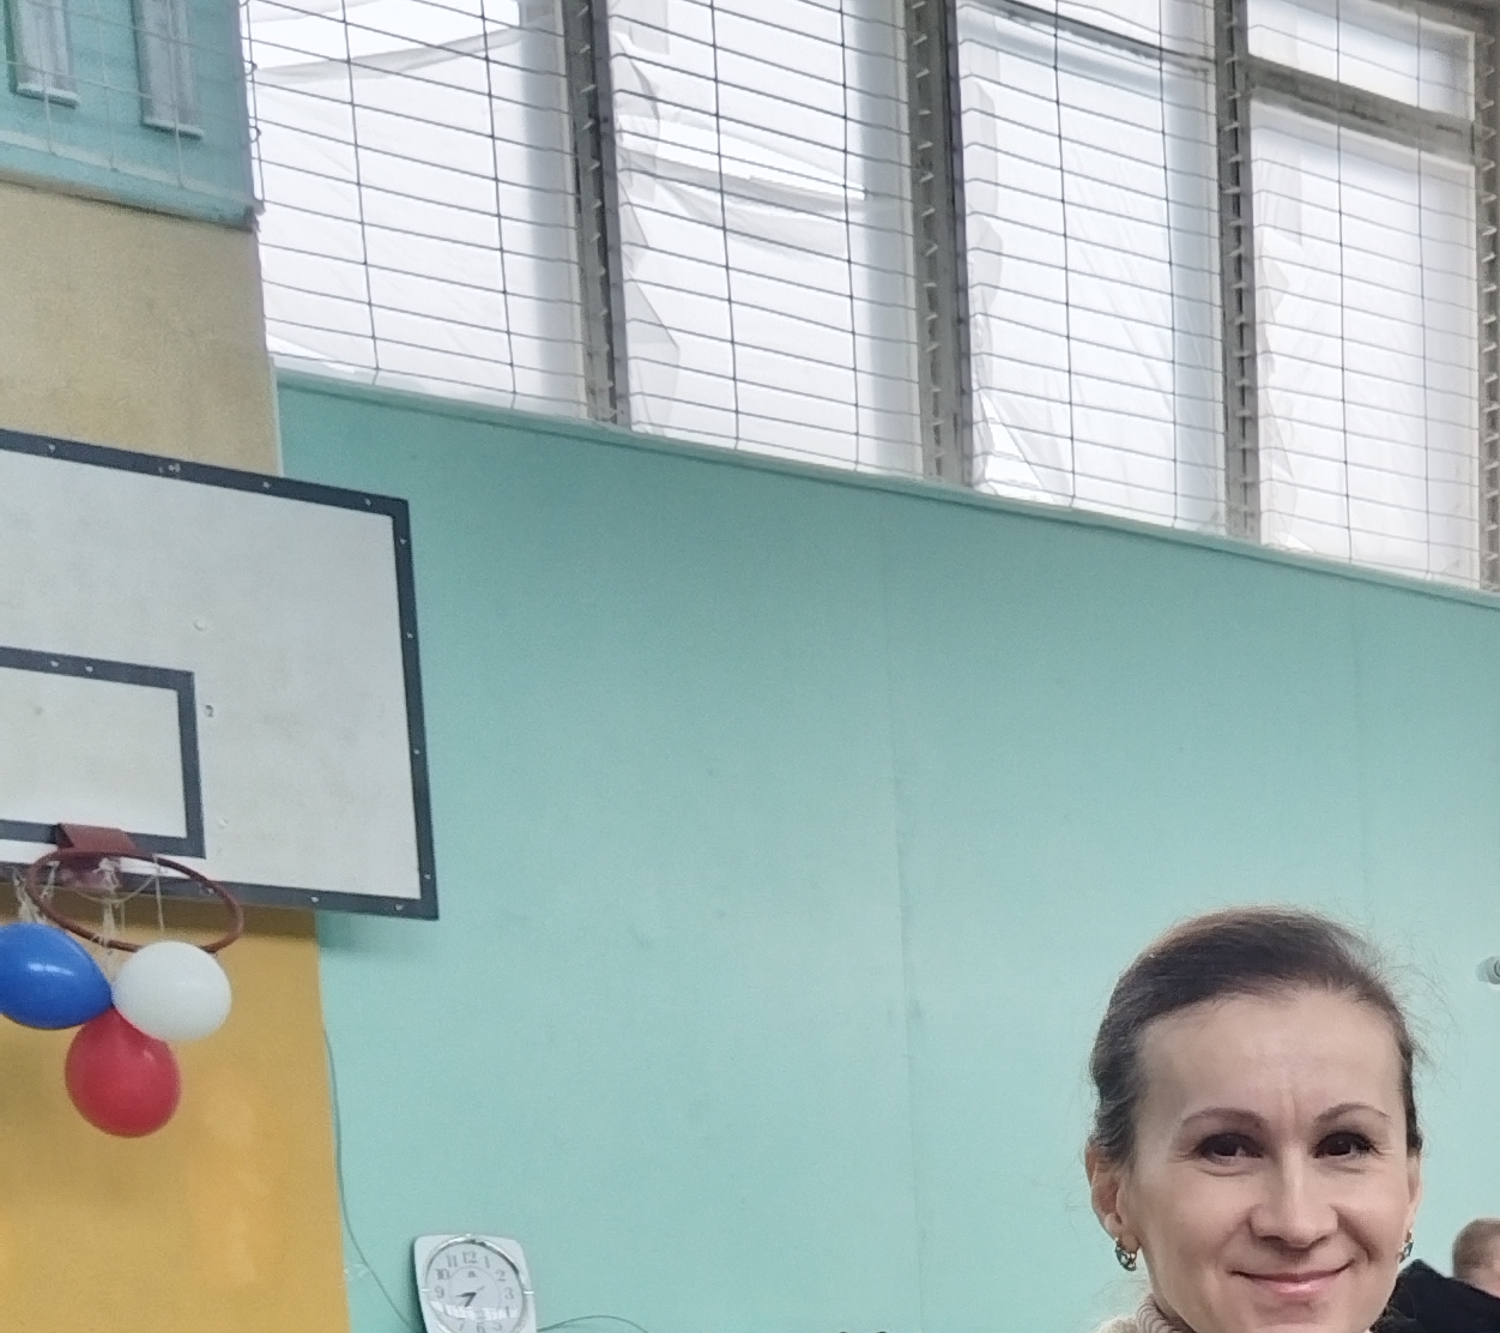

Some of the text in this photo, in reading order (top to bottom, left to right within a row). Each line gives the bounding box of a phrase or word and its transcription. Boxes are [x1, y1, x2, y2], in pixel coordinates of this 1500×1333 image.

[447, 1255, 458, 1267] 11
[463, 1251, 477, 1264] 12
[436, 1268, 451, 1280] 10
[495, 1270, 506, 1282] 2
[504, 1287, 514, 1300] 3
